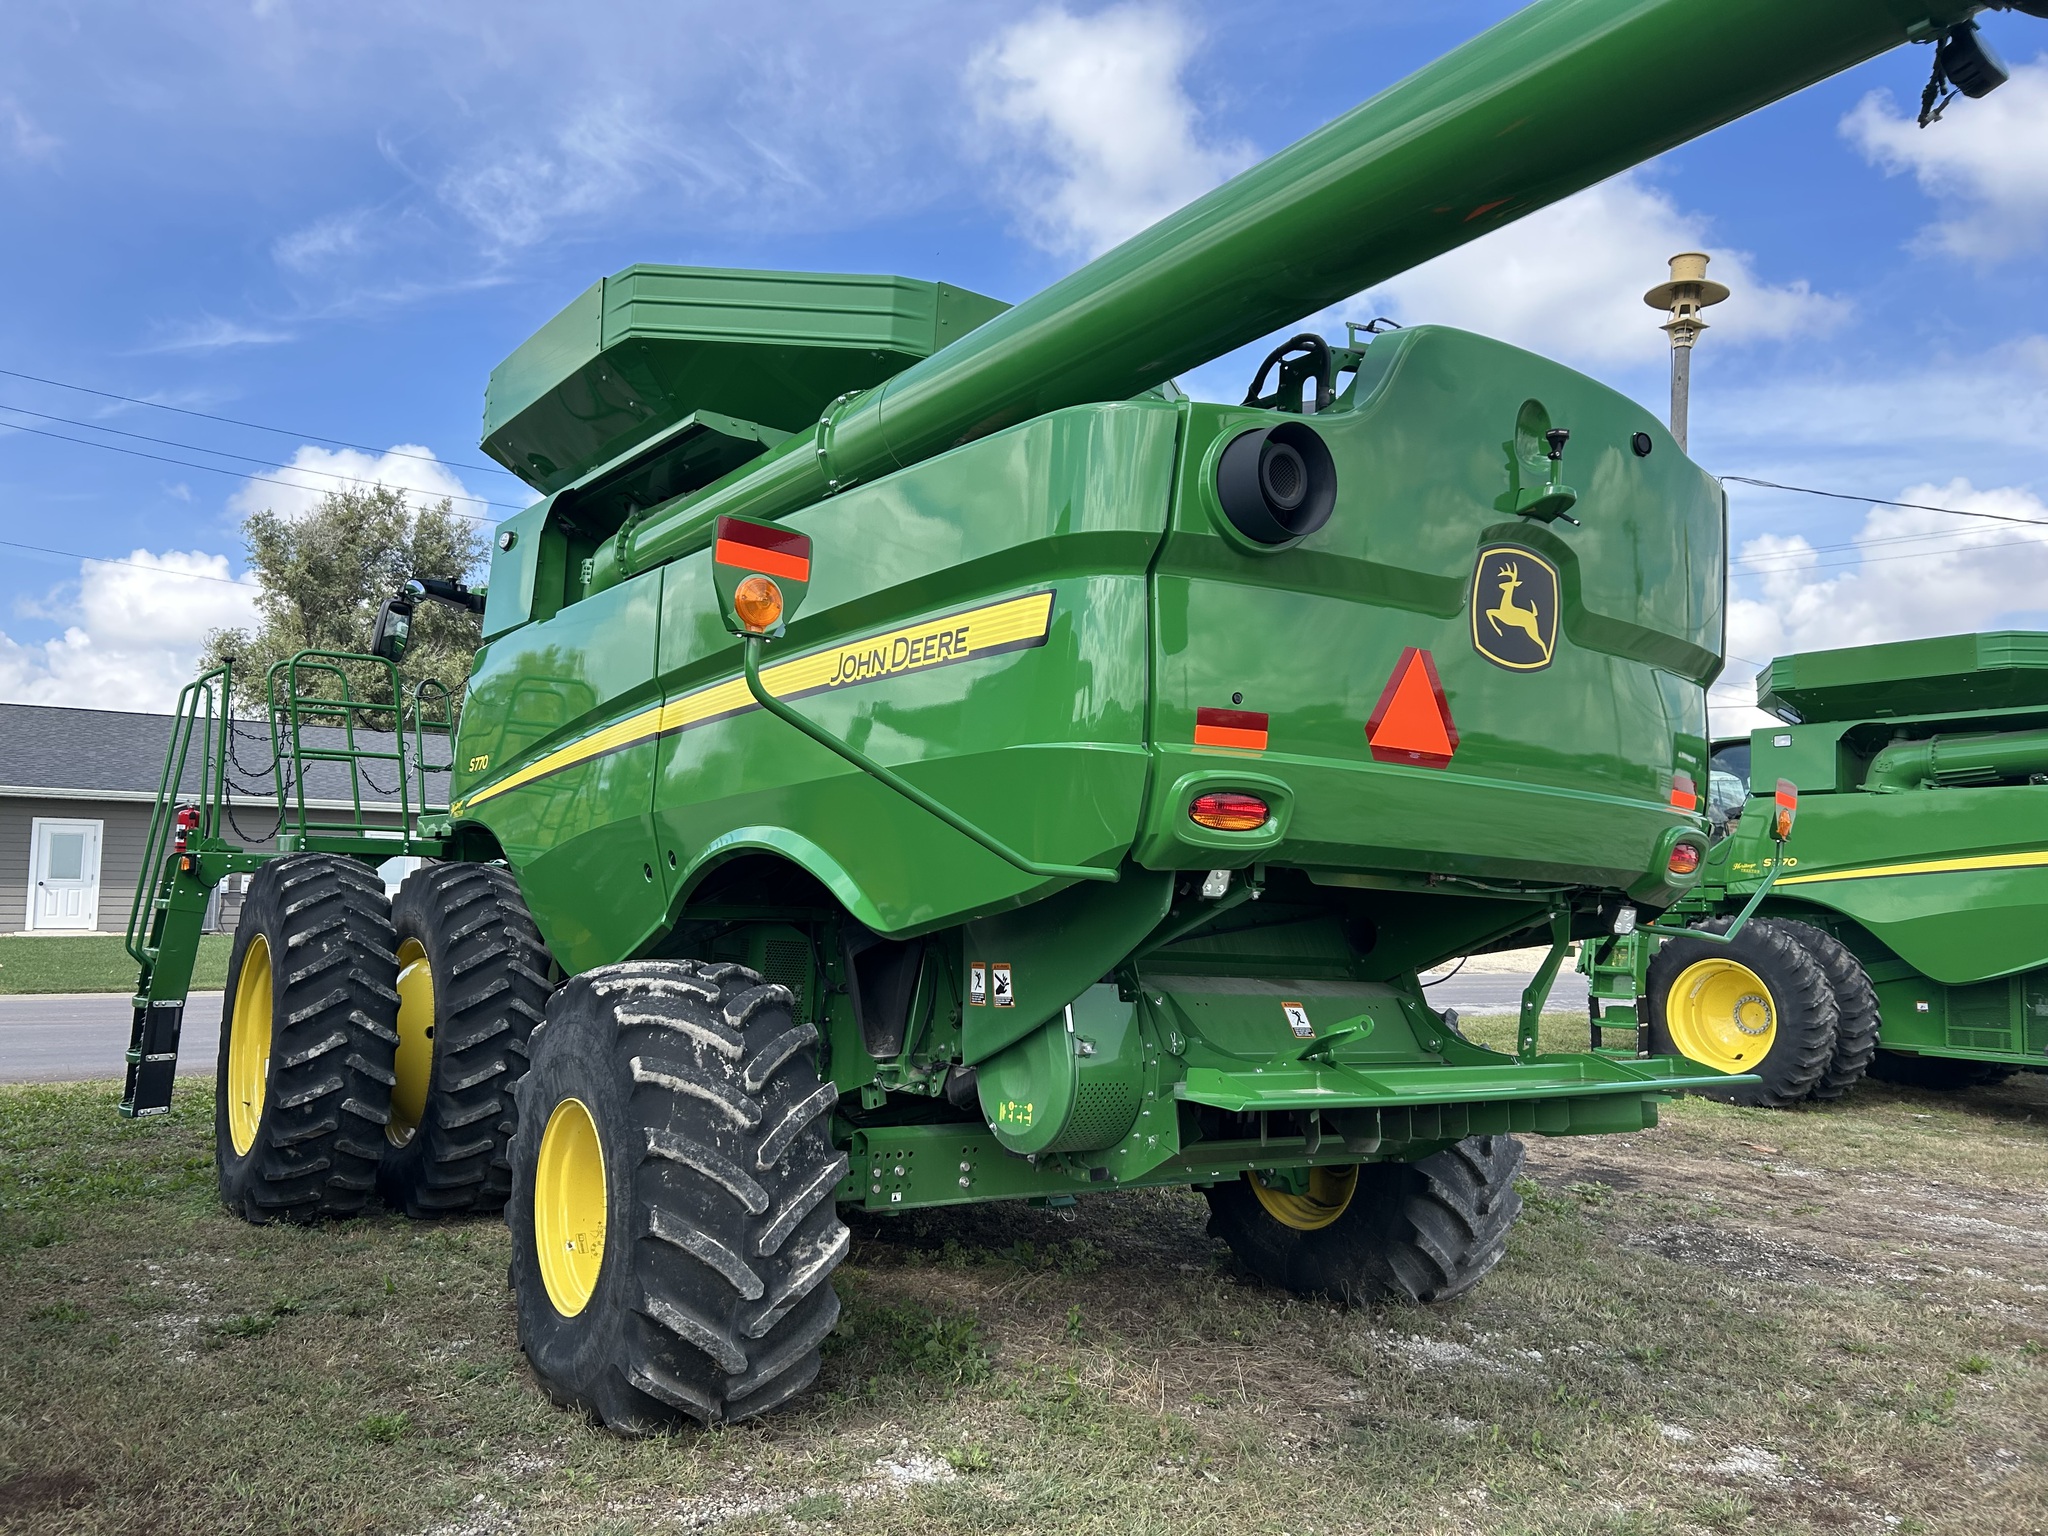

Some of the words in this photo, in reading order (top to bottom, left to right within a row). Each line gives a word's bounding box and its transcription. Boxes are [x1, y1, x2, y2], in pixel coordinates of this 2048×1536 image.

[830, 646, 887, 683] JOHN
[891, 626, 970, 669] DEERE
[468, 754, 489, 773] S770
[1763, 857, 1798, 867] S70
